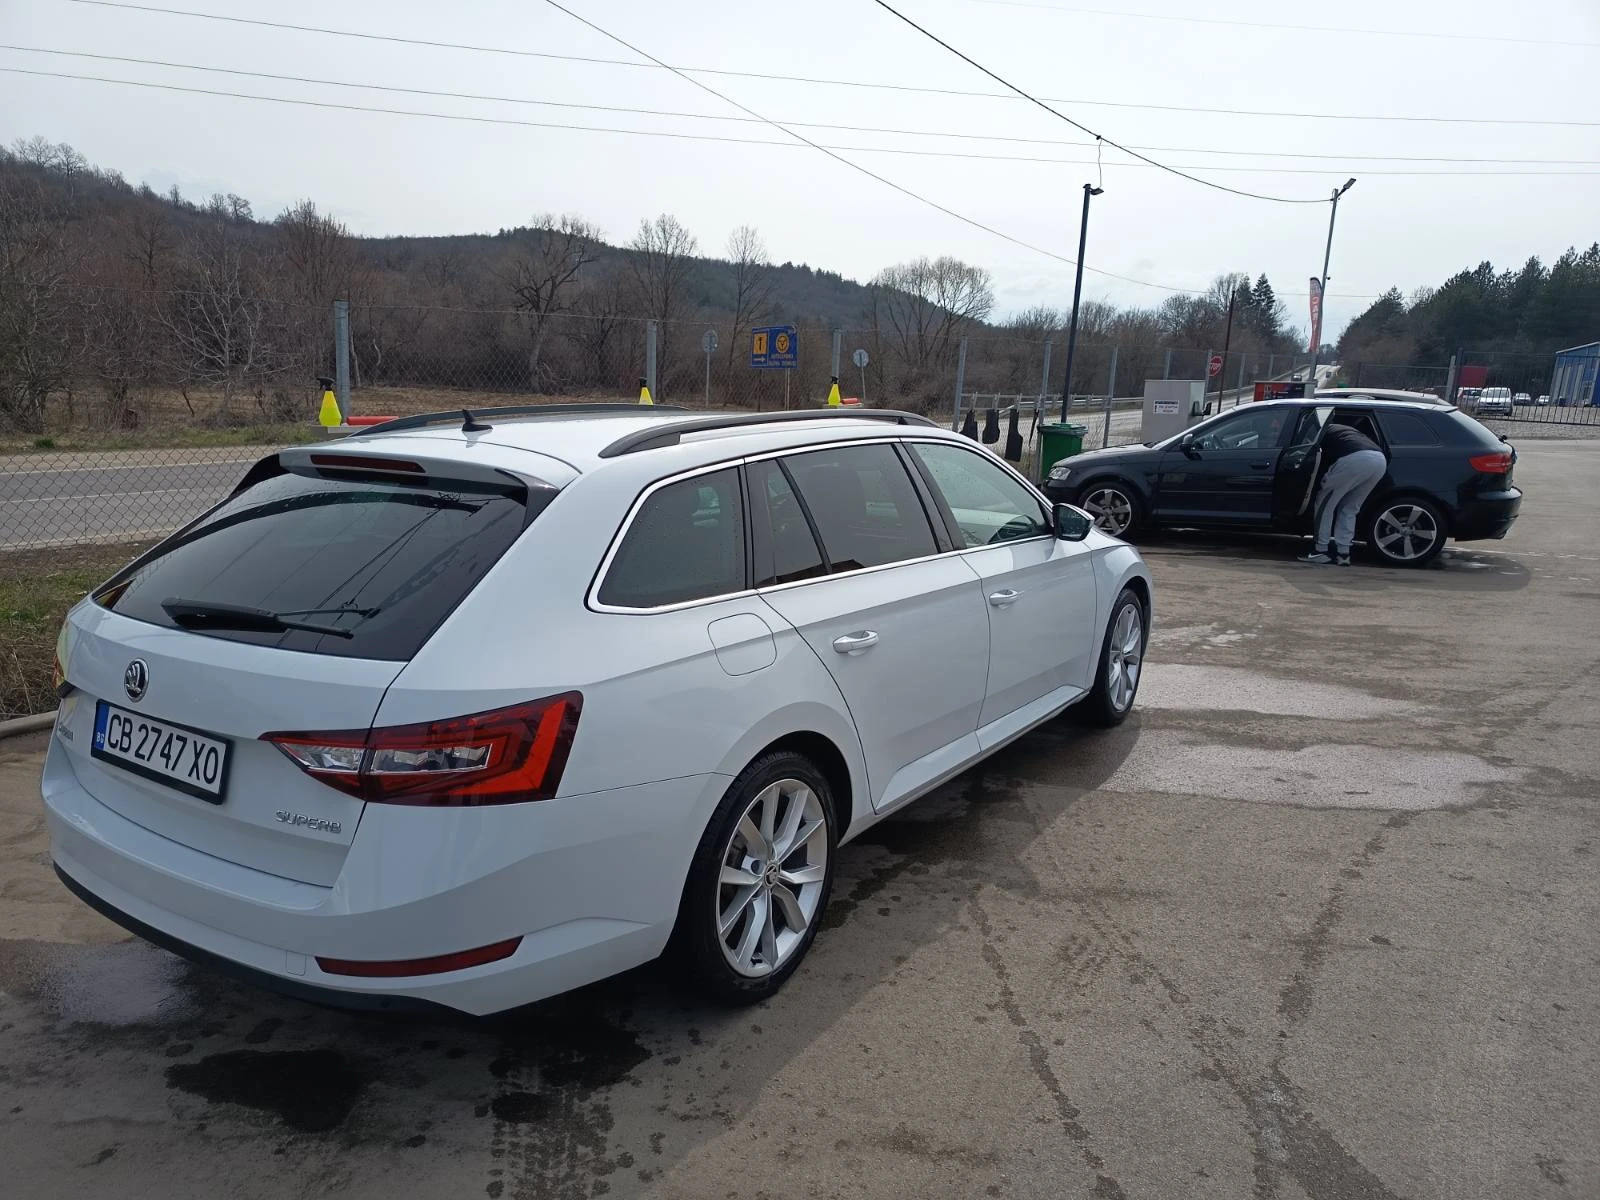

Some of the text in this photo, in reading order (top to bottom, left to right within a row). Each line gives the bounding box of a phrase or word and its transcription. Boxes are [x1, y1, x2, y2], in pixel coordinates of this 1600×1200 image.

[96, 731, 105, 743] BG
[108, 714, 133, 753] CB
[135, 723, 187, 771] 2747
[275, 809, 342, 834] SUPERB
